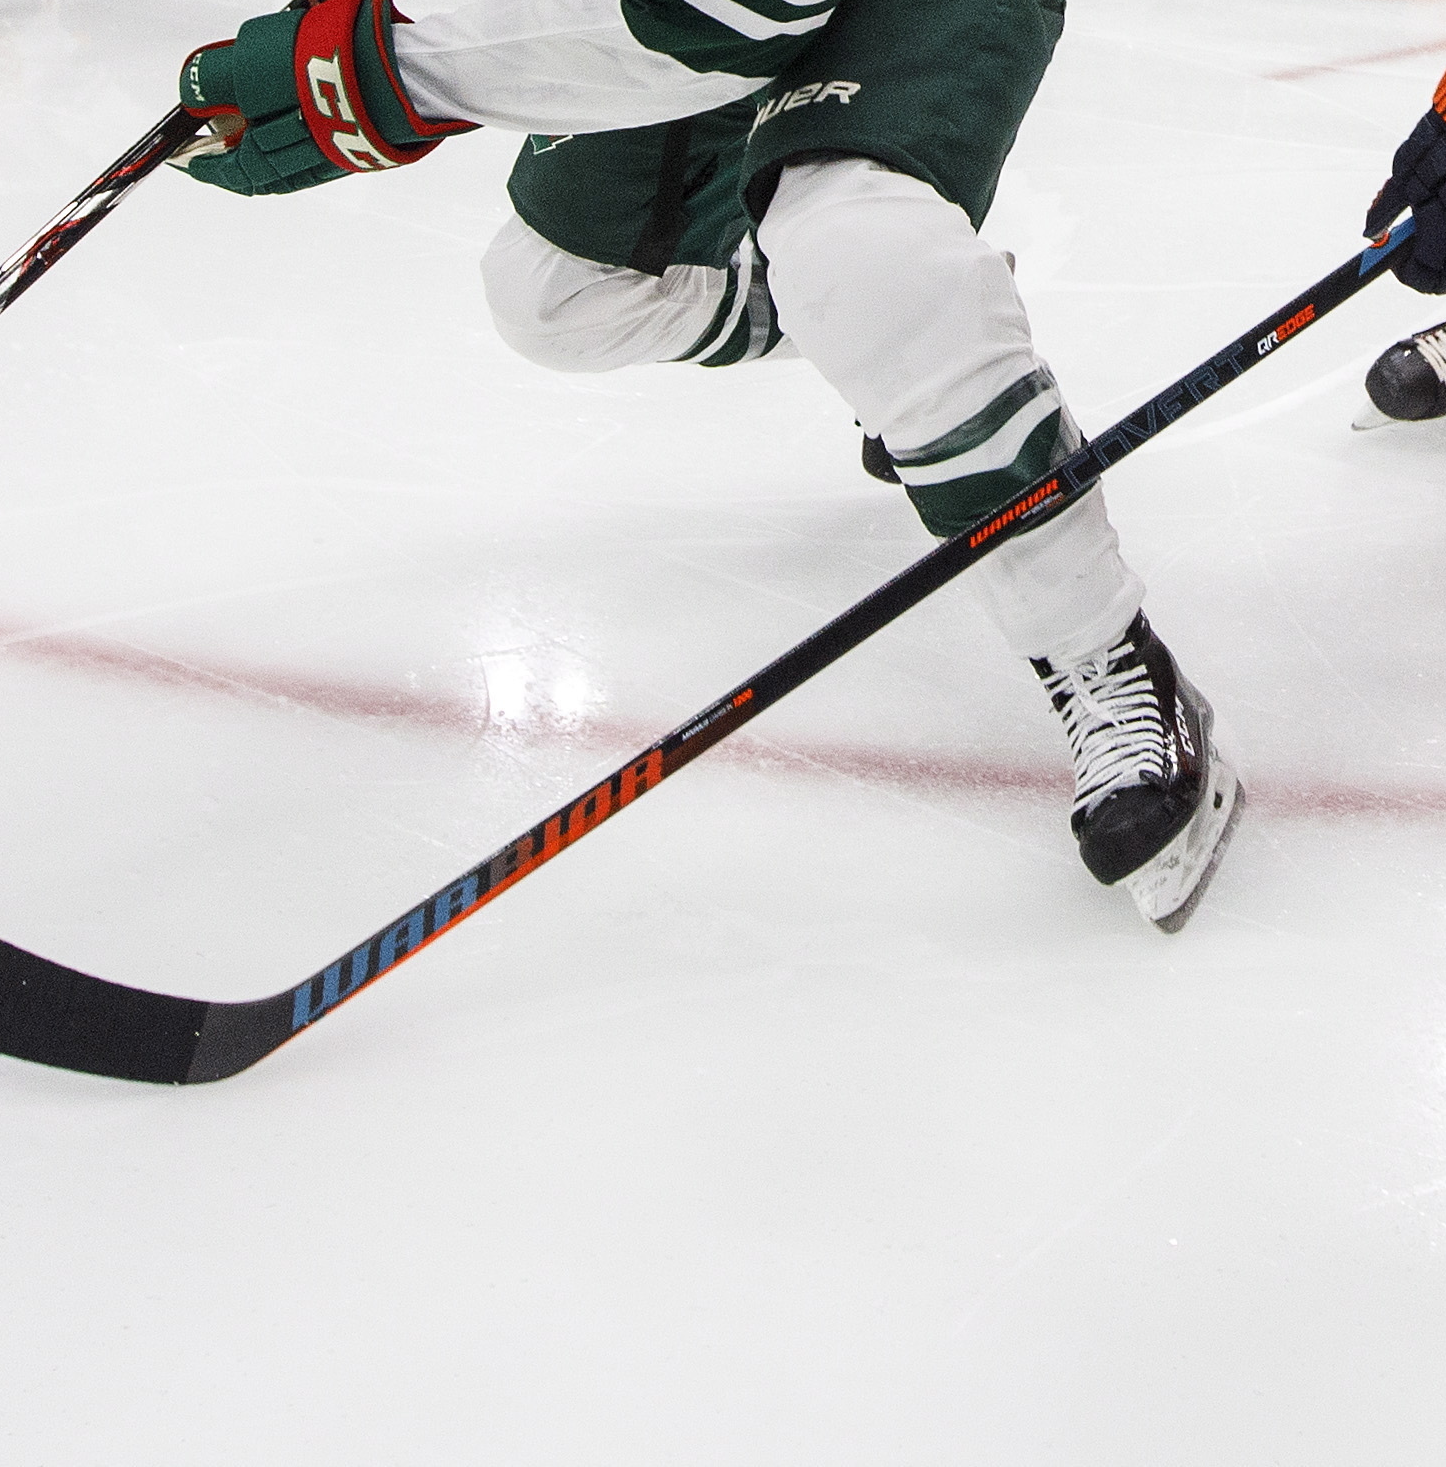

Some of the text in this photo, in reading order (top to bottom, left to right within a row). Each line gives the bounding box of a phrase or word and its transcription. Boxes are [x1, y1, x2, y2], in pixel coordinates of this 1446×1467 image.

[307, 44, 404, 171] CC
[969, 478, 1059, 549] WARRIOR
[291, 748, 664, 1032] WARRIOR
